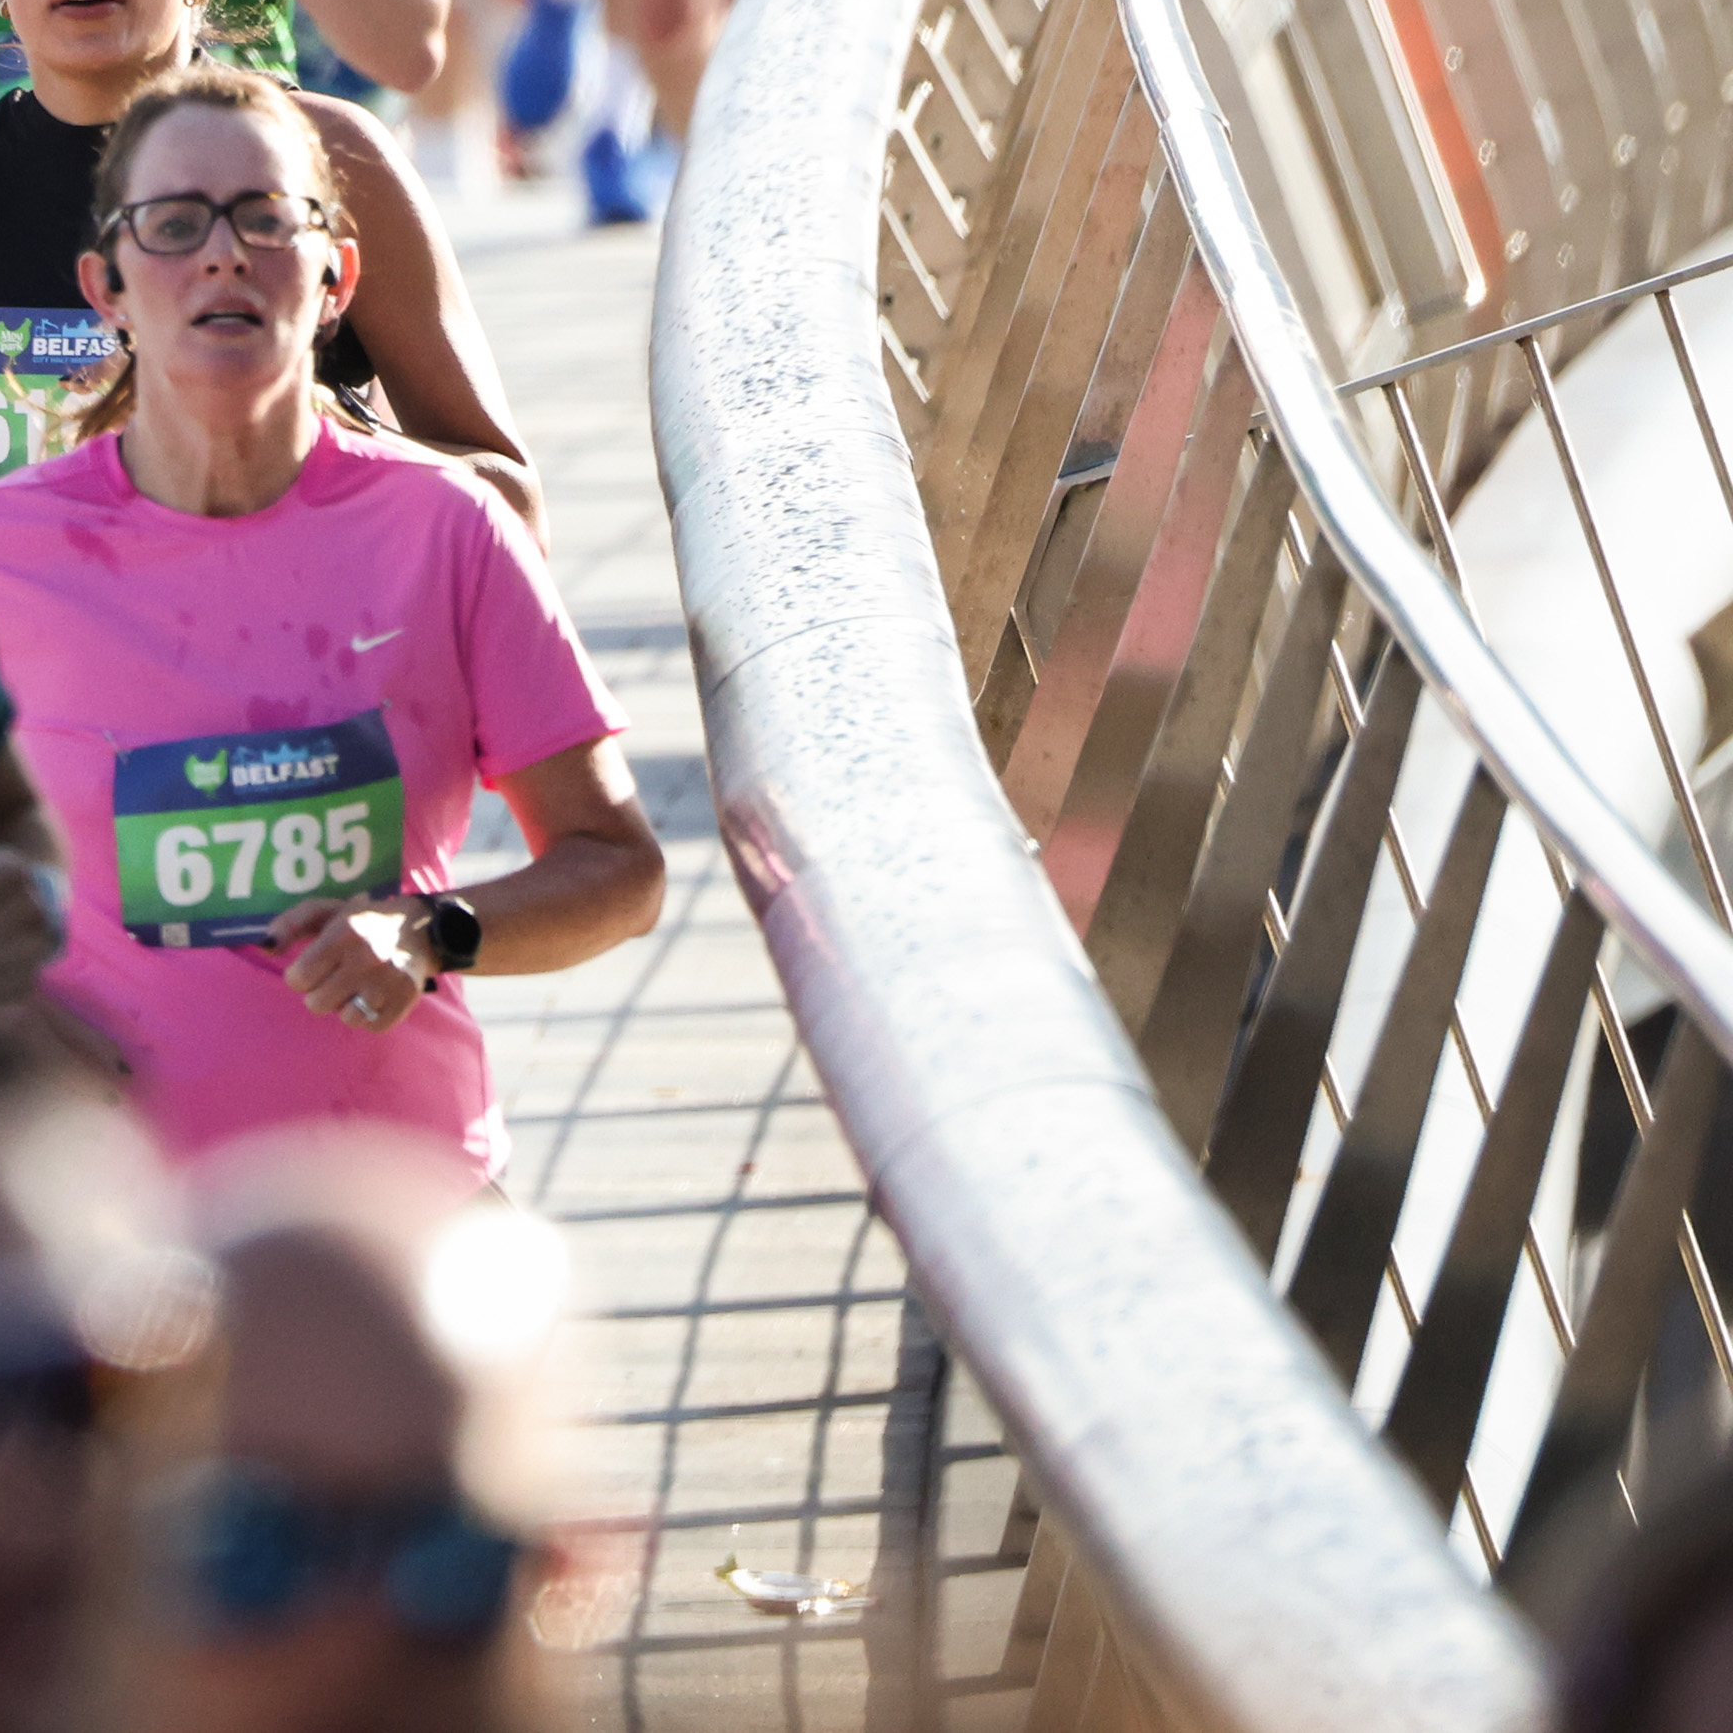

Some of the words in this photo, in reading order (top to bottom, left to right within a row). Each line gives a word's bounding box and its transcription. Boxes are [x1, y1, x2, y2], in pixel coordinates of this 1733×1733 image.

[32, 337, 118, 357] BELFAS
[231, 754, 340, 787] BELFAST
[155, 801, 372, 907] 6785
